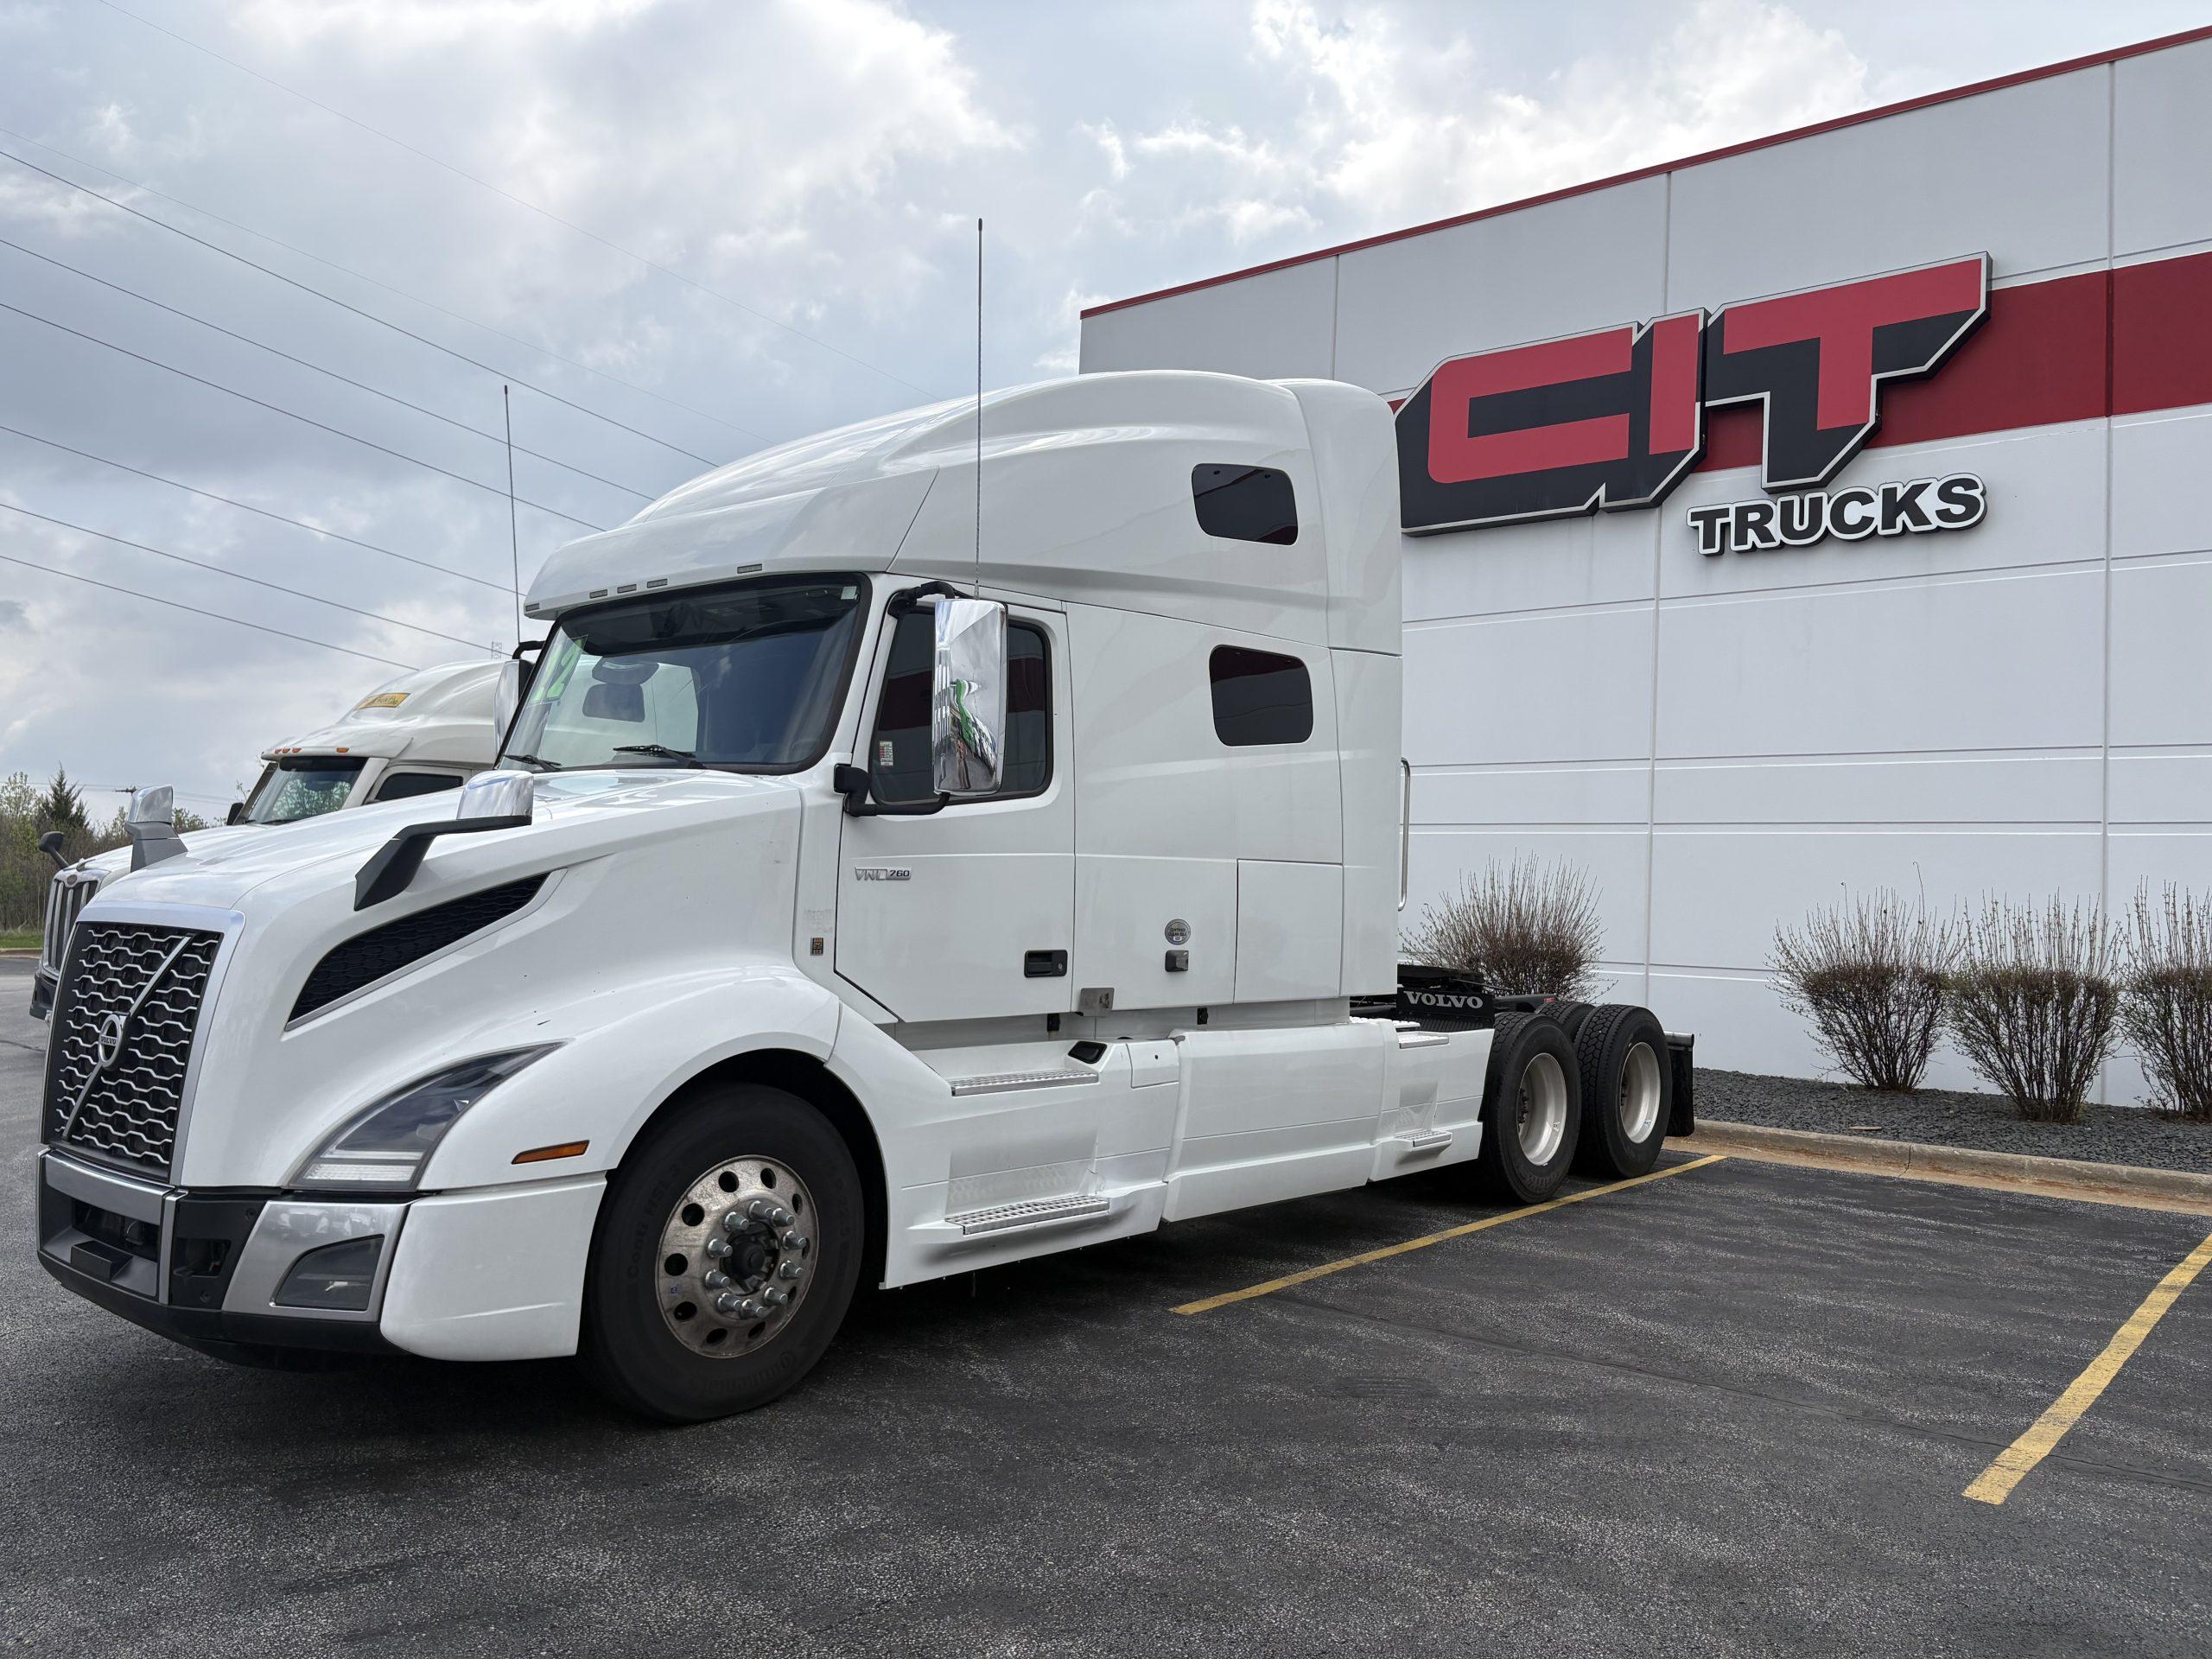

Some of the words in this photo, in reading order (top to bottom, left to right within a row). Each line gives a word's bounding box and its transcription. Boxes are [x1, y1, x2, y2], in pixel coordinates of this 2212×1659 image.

[1417, 252, 1987, 497] CIT
[1688, 474, 1976, 553] TRUCKS
[889, 869, 911, 878] 760
[1403, 990, 1484, 1009] VOLVO
[100, 1036, 117, 1045] VOLVO
